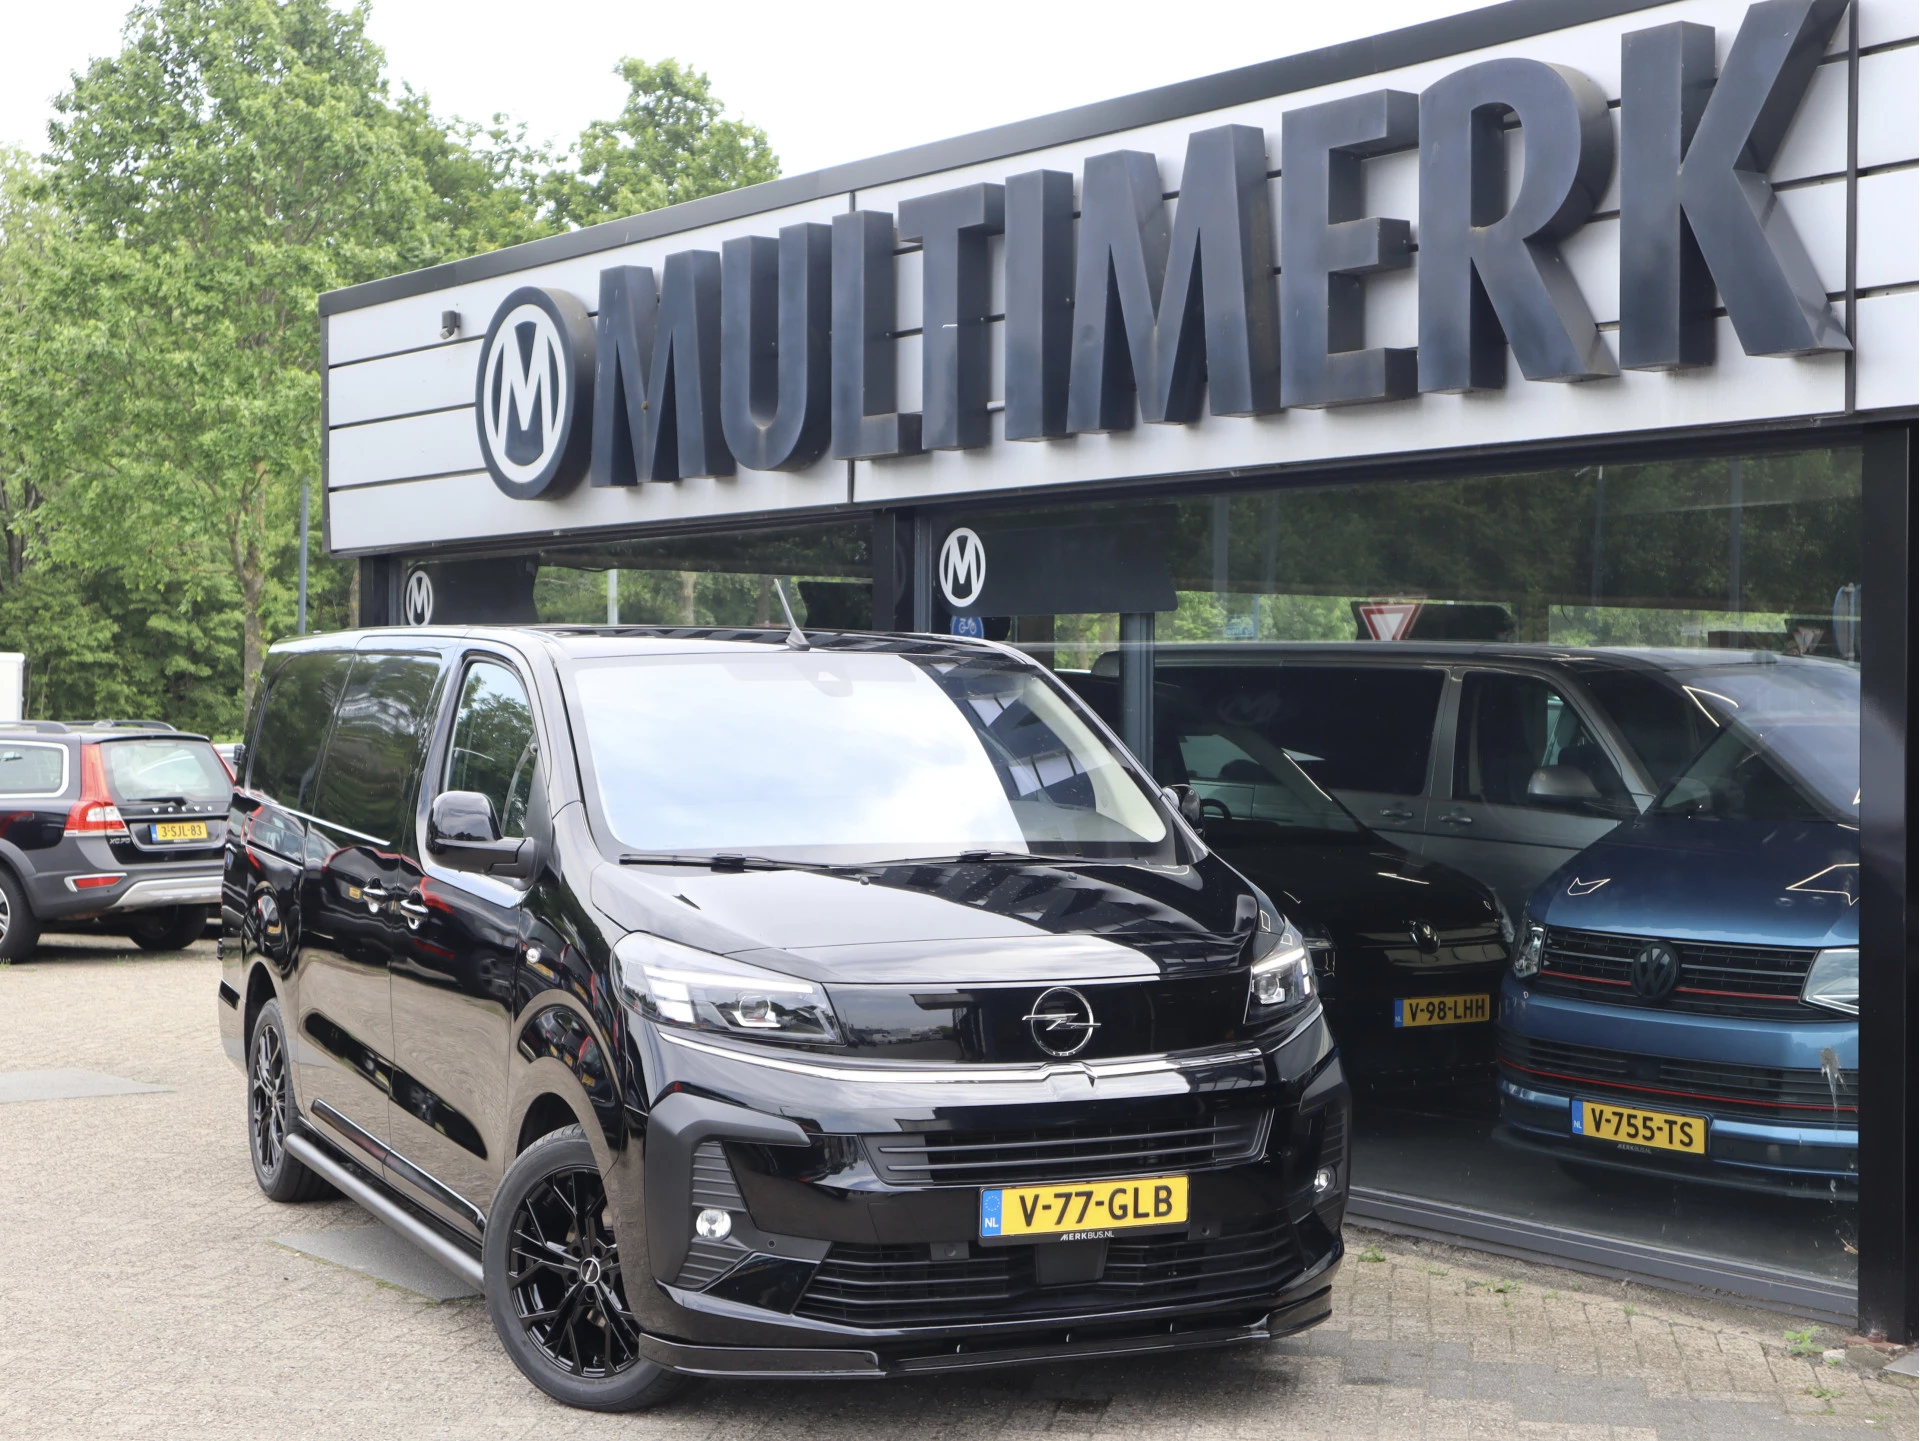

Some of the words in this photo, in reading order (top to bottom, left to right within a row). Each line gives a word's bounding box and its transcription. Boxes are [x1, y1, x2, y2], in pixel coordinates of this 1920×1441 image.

[590, 0, 1852, 488] MULTIMERK
[161, 824, 203, 838] 3-SJL-83
[1408, 998, 1485, 1022] V-98-LHH
[1573, 1120, 1582, 1129] NL
[1591, 1107, 1694, 1148] V-755-TS
[984, 1217, 999, 1229] NL
[1018, 1184, 1173, 1228] V-77-GLB
[1060, 1230, 1115, 1242] MERKBUS.NL
